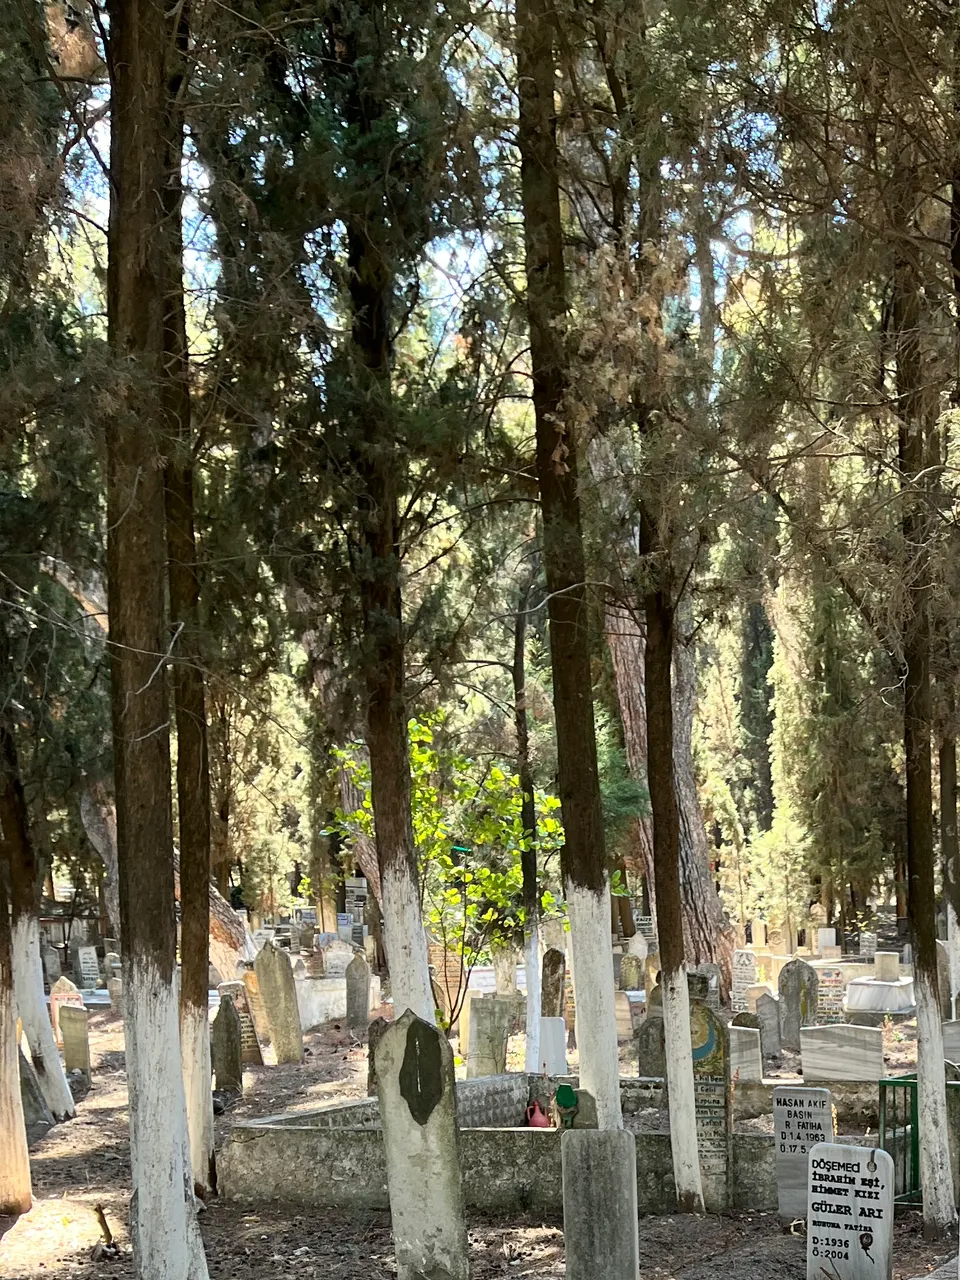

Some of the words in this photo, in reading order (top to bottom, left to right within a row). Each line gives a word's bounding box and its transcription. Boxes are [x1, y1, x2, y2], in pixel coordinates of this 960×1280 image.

[776, 1098, 804, 1107] HASAN
[812, 1171, 856, 1185] İBRAHİM
[854, 1189, 880, 1200] KIZI
[812, 1200, 852, 1216] GÜLER
[859, 1207, 883, 1219] ARI
[812, 1236, 850, 1248] D:1936
[812, 1247, 849, 1260] Ö:2004
